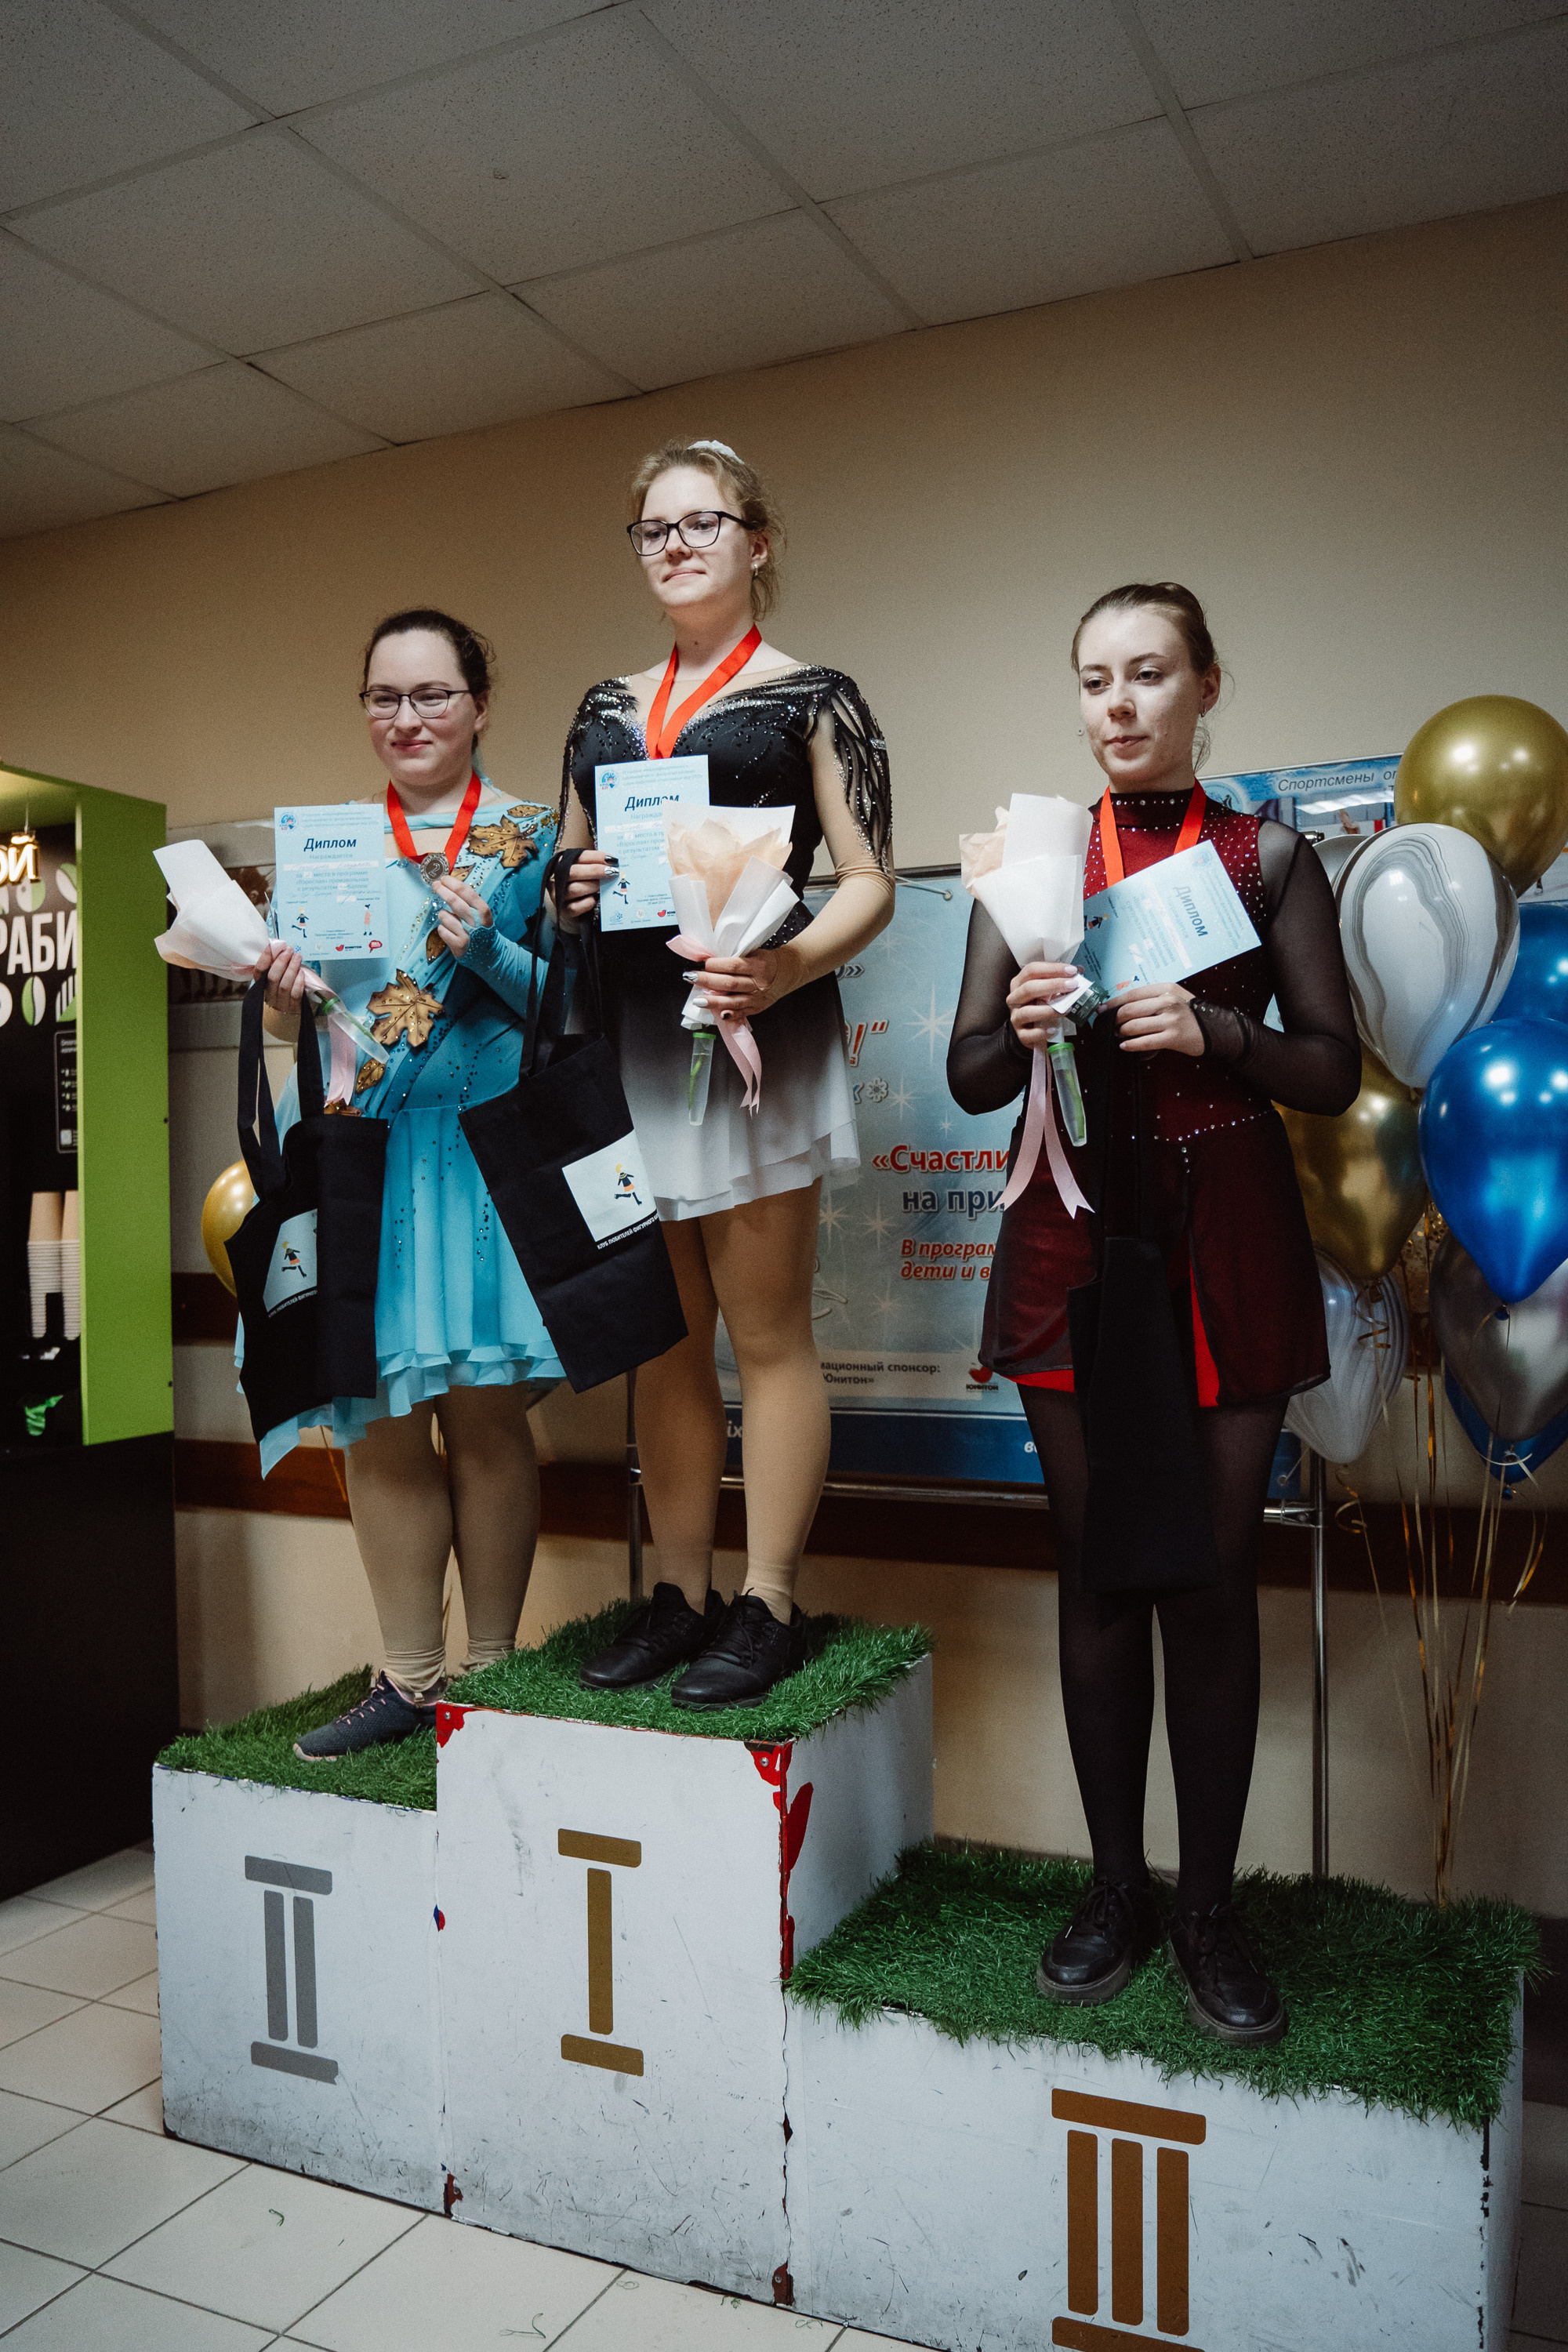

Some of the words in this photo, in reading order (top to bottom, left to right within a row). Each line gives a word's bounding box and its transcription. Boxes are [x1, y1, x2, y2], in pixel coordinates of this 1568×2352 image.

[1279, 772, 1374, 792] Спортсмены
[303, 838, 357, 852] Диплом
[430, 862, 441, 877] 2
[1174, 885, 1208, 937] Диплом
[902, 1189, 939, 1213] на
[901, 1240, 916, 1258] В
[901, 1261, 956, 1280] дети
[961, 1265, 975, 1280] и
[888, 1363, 941, 1375] спонсор:
